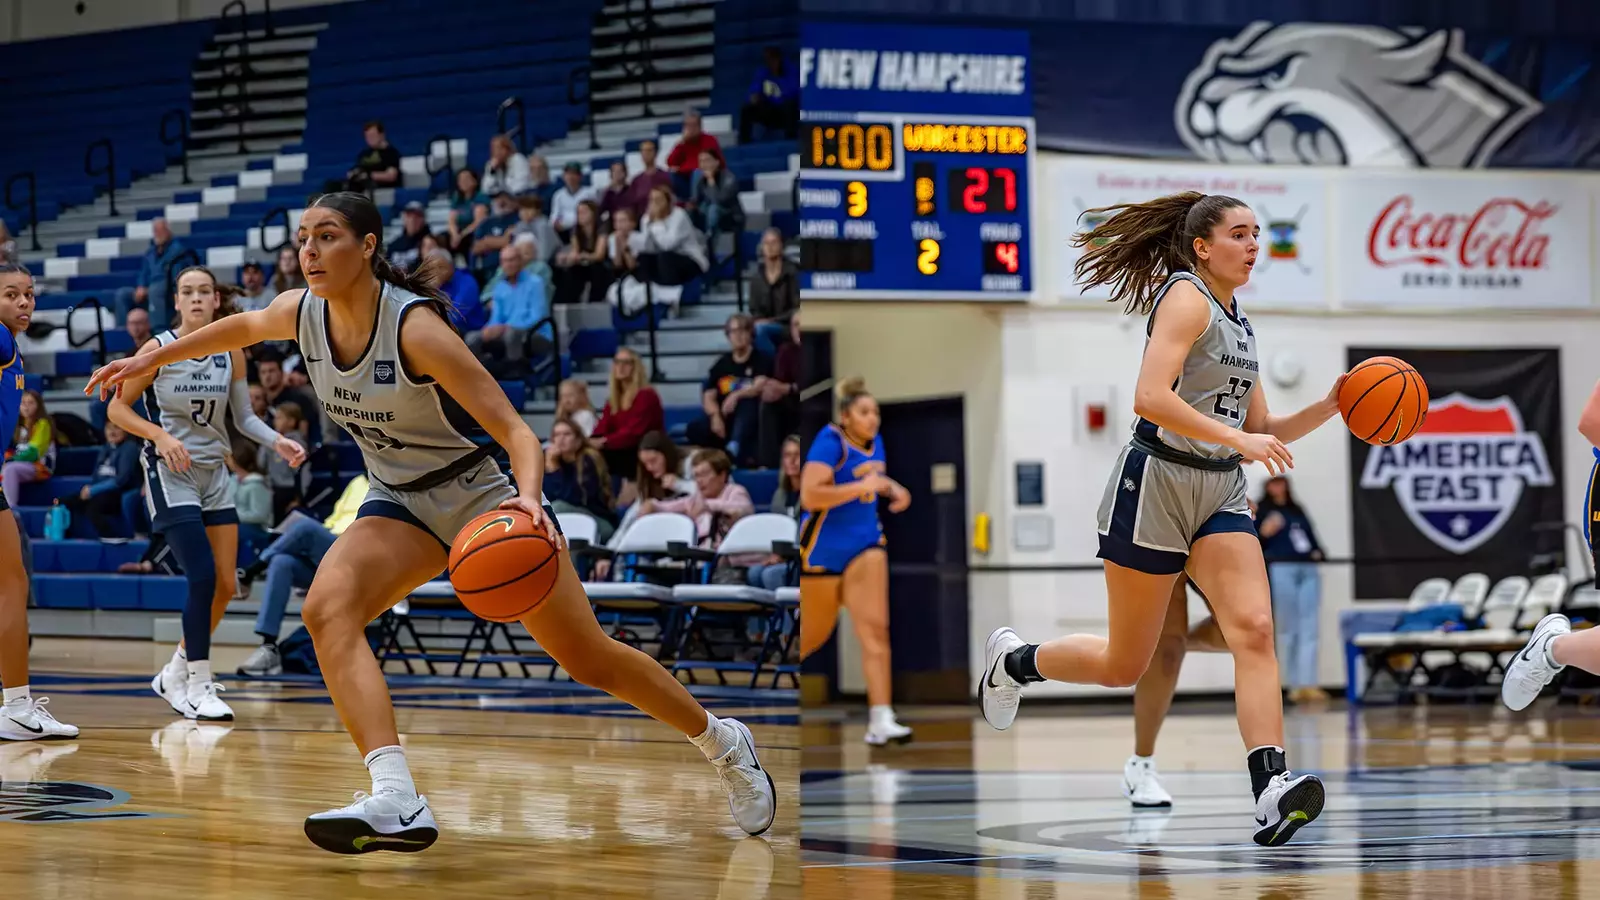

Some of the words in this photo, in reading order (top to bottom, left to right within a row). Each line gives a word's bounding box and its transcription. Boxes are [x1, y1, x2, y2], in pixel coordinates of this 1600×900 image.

[816, 49, 878, 90] NEW
[878, 51, 1026, 95] HAMPSHIRE
[812, 124, 893, 170] 1:00
[903, 124, 1027, 153] WORCESTER
[847, 181, 868, 218] 3
[963, 167, 1017, 213] 27
[917, 238, 940, 275] 2
[996, 242, 1018, 273] 4
[1402, 273, 1453, 288] ZERO
[1458, 273, 1523, 289] SUGAR
[1220, 354, 1259, 372] HAMPSHIR
[174, 385, 227, 393] HAMPSHIRE
[334, 386, 361, 403] NEW
[190, 399, 217, 427] 21
[321, 400, 396, 422] AMPSHIRE
[1373, 440, 1543, 478] AMERICA
[1411, 475, 1503, 501] EAST
